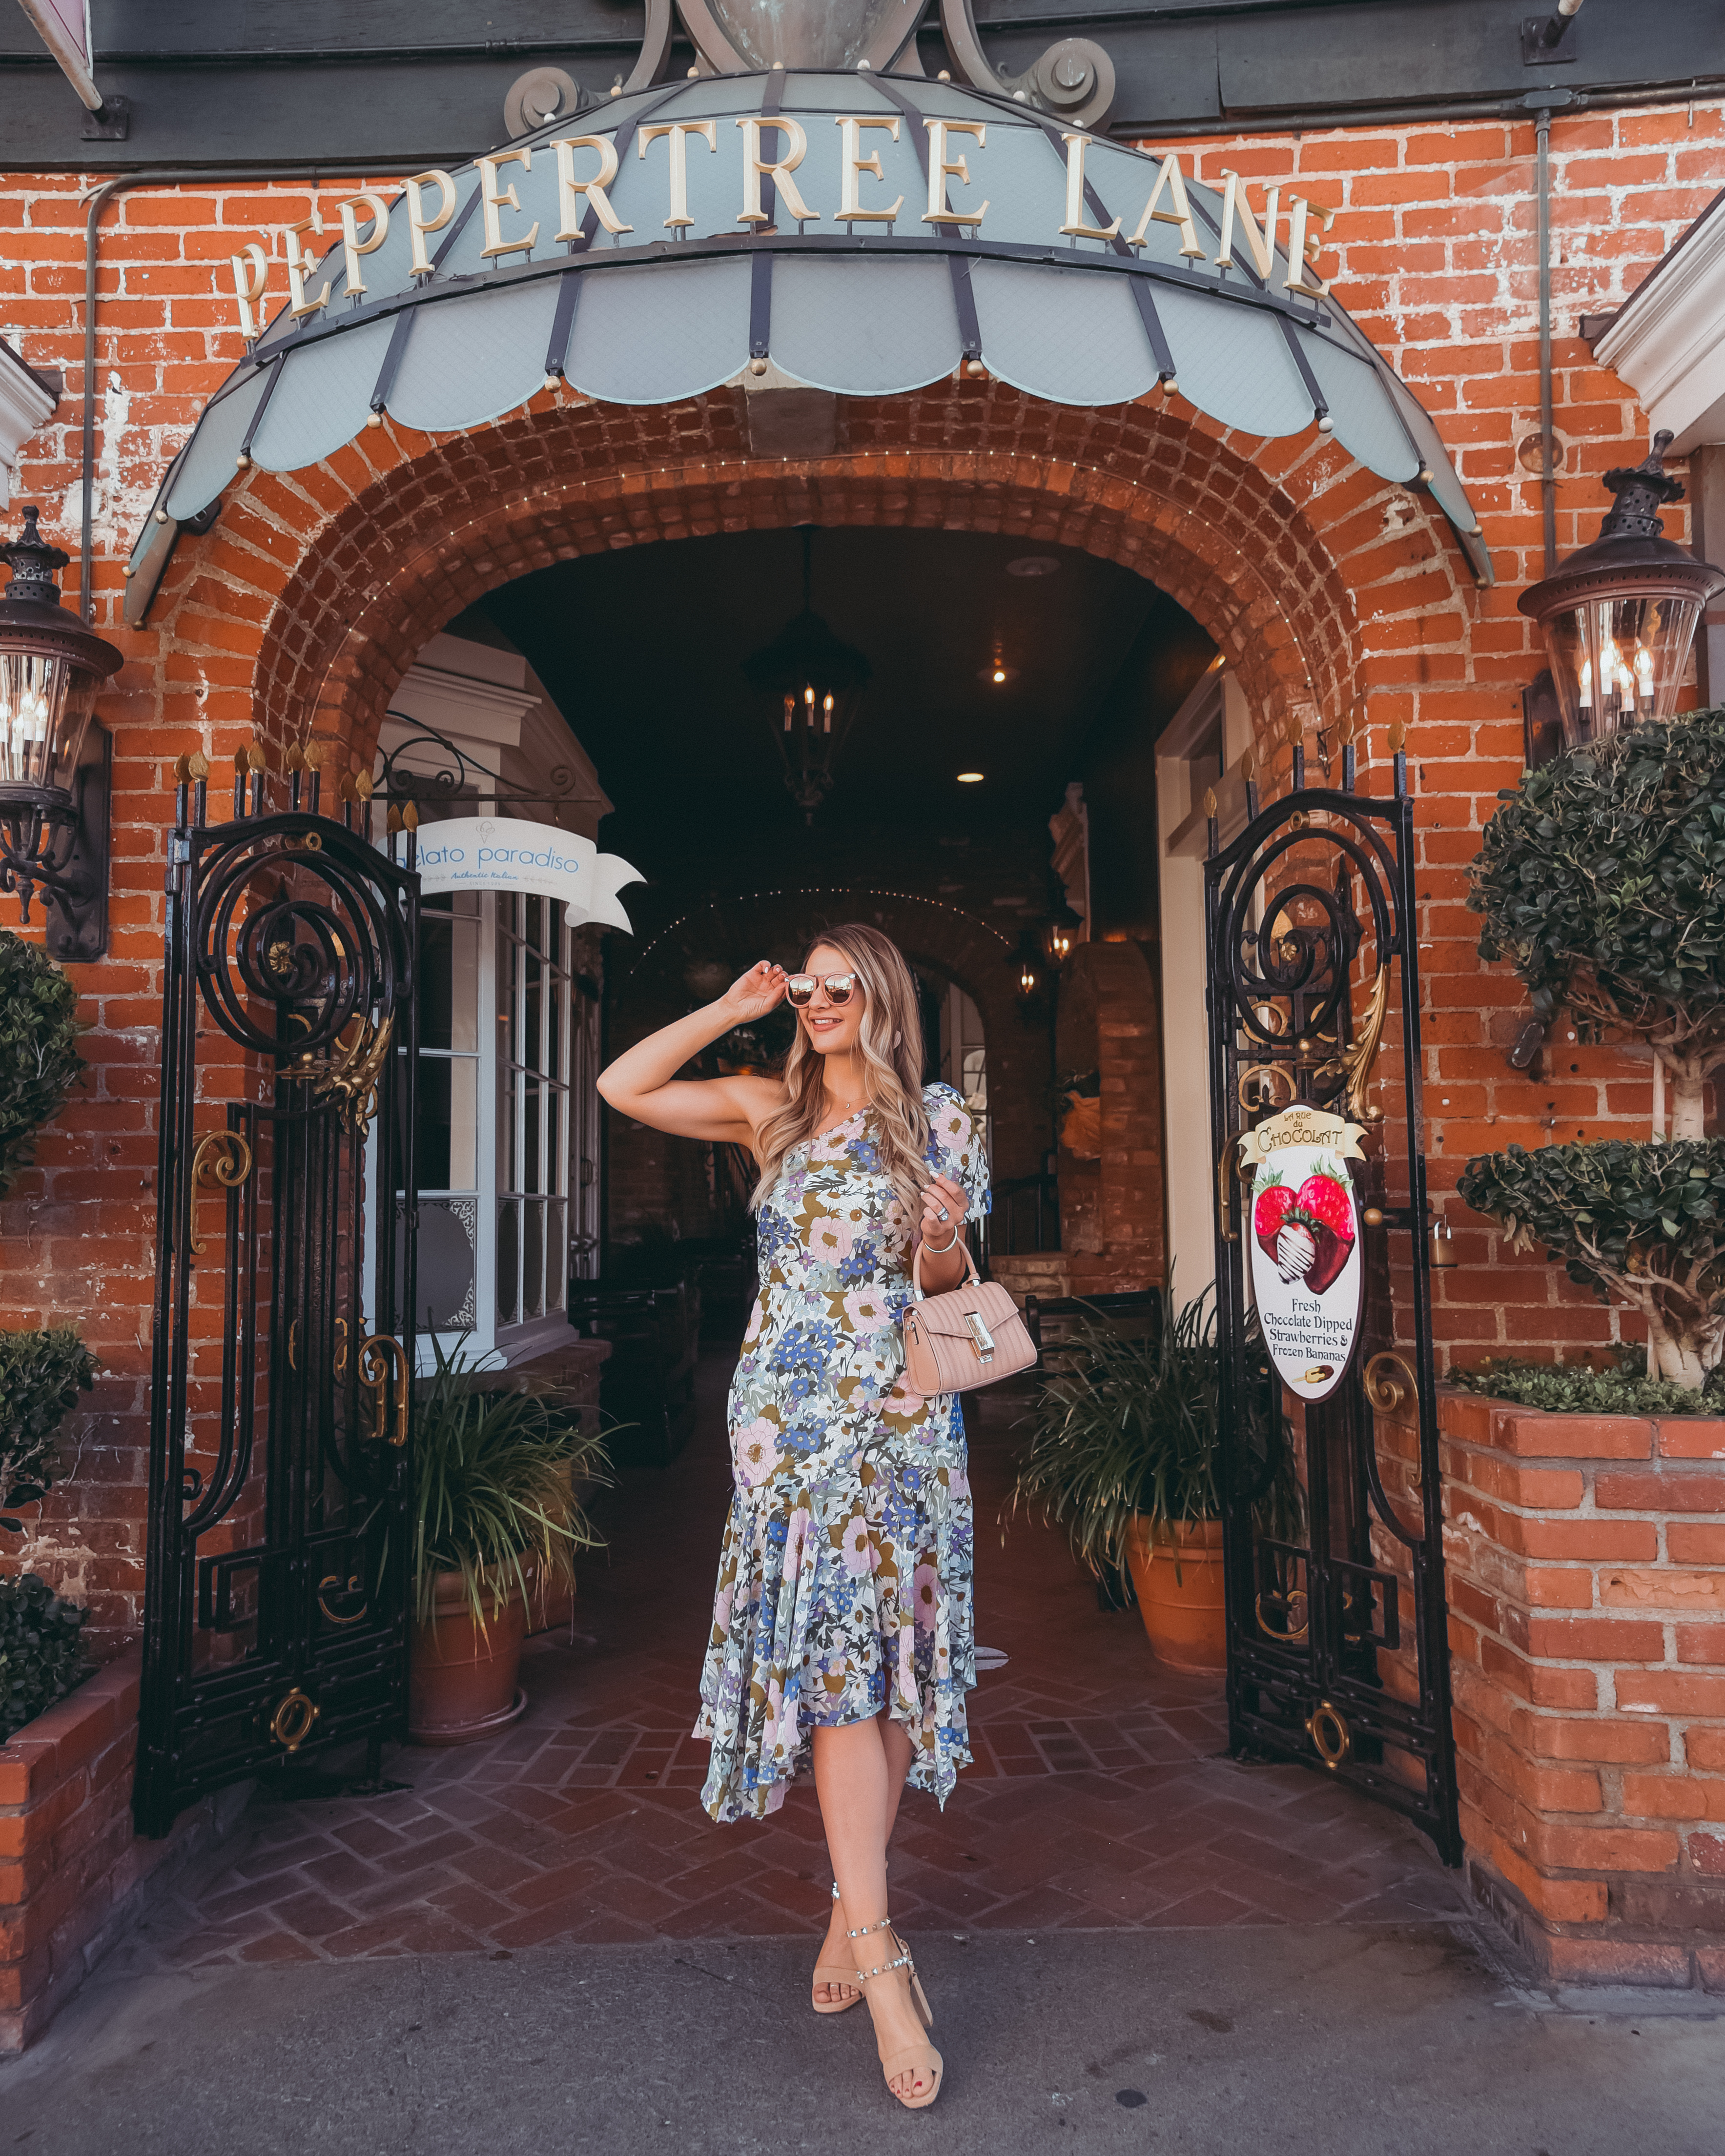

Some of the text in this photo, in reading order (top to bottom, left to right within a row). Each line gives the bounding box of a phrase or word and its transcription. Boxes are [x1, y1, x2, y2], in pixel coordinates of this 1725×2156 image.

[230, 116, 1335, 343] PEPPERTREE LANE
[478, 846, 579, 873] paradiso
[451, 871, 519, 880] Authentic Italian
[1284, 1113, 1294, 1122] LA
[1257, 1126, 1343, 1153] CHOCOLAT
[1292, 1298, 1321, 1314] Fresh
[1264, 1312, 1353, 1333] Chocolate Dipped
[1270, 1328, 1348, 1347] Strawberries &
[1273, 1343, 1346, 1362] Frozen Bananas
